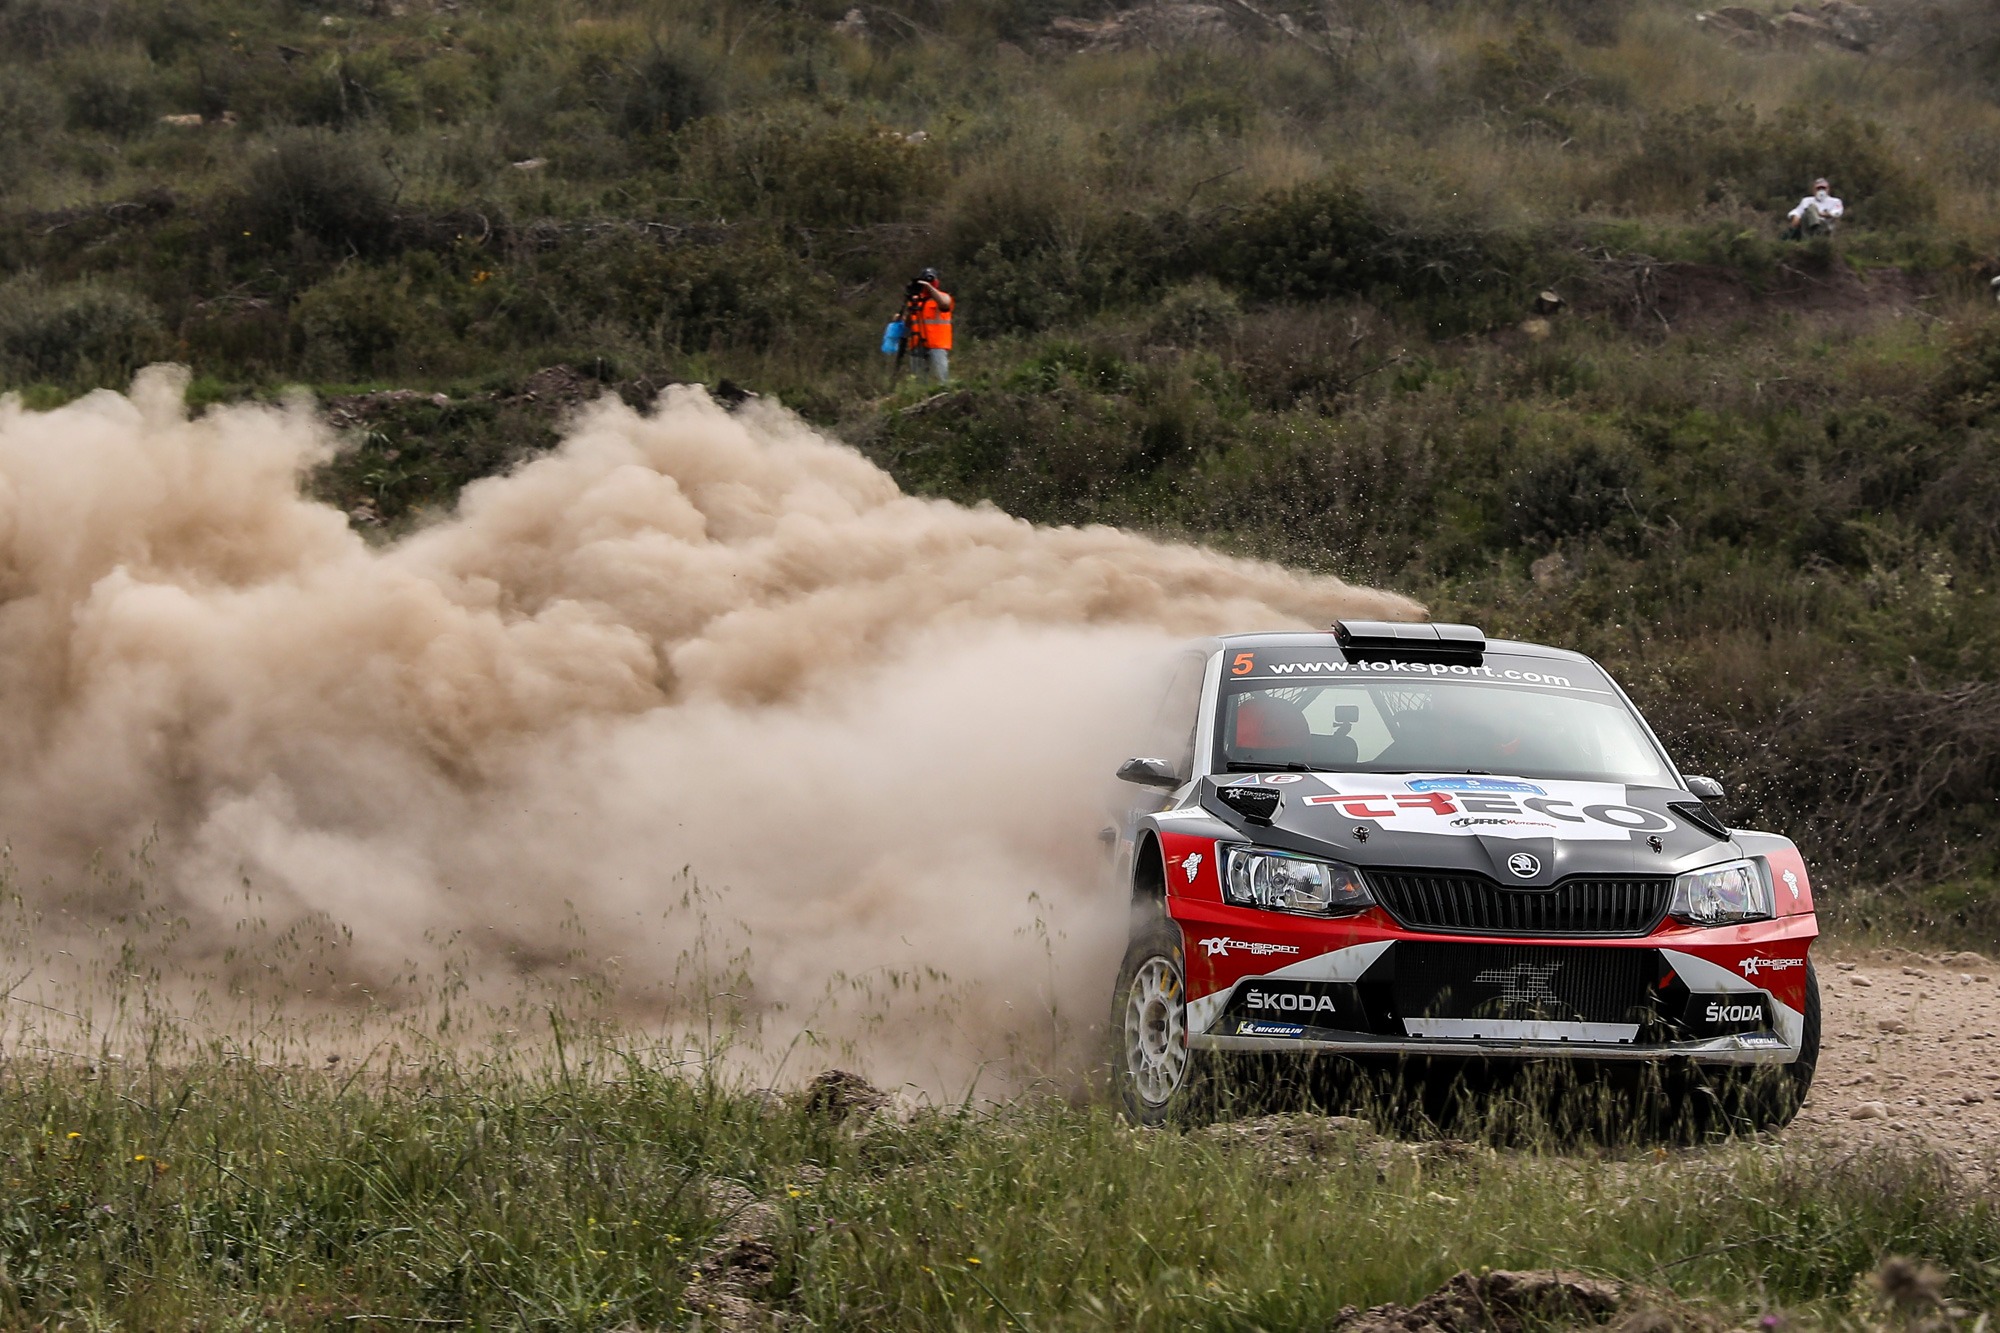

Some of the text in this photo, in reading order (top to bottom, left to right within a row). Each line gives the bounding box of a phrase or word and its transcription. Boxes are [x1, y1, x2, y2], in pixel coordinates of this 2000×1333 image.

[1231, 653, 1571, 687] 5 www.toksport.com
[1312, 791, 1668, 831] TRECO
[1228, 940, 1300, 953] TOKSPORT
[1246, 988, 1336, 1012] ŠKODA
[1705, 1002, 1762, 1022] ŠKODA
[1254, 1026, 1303, 1034] MICHELIN
